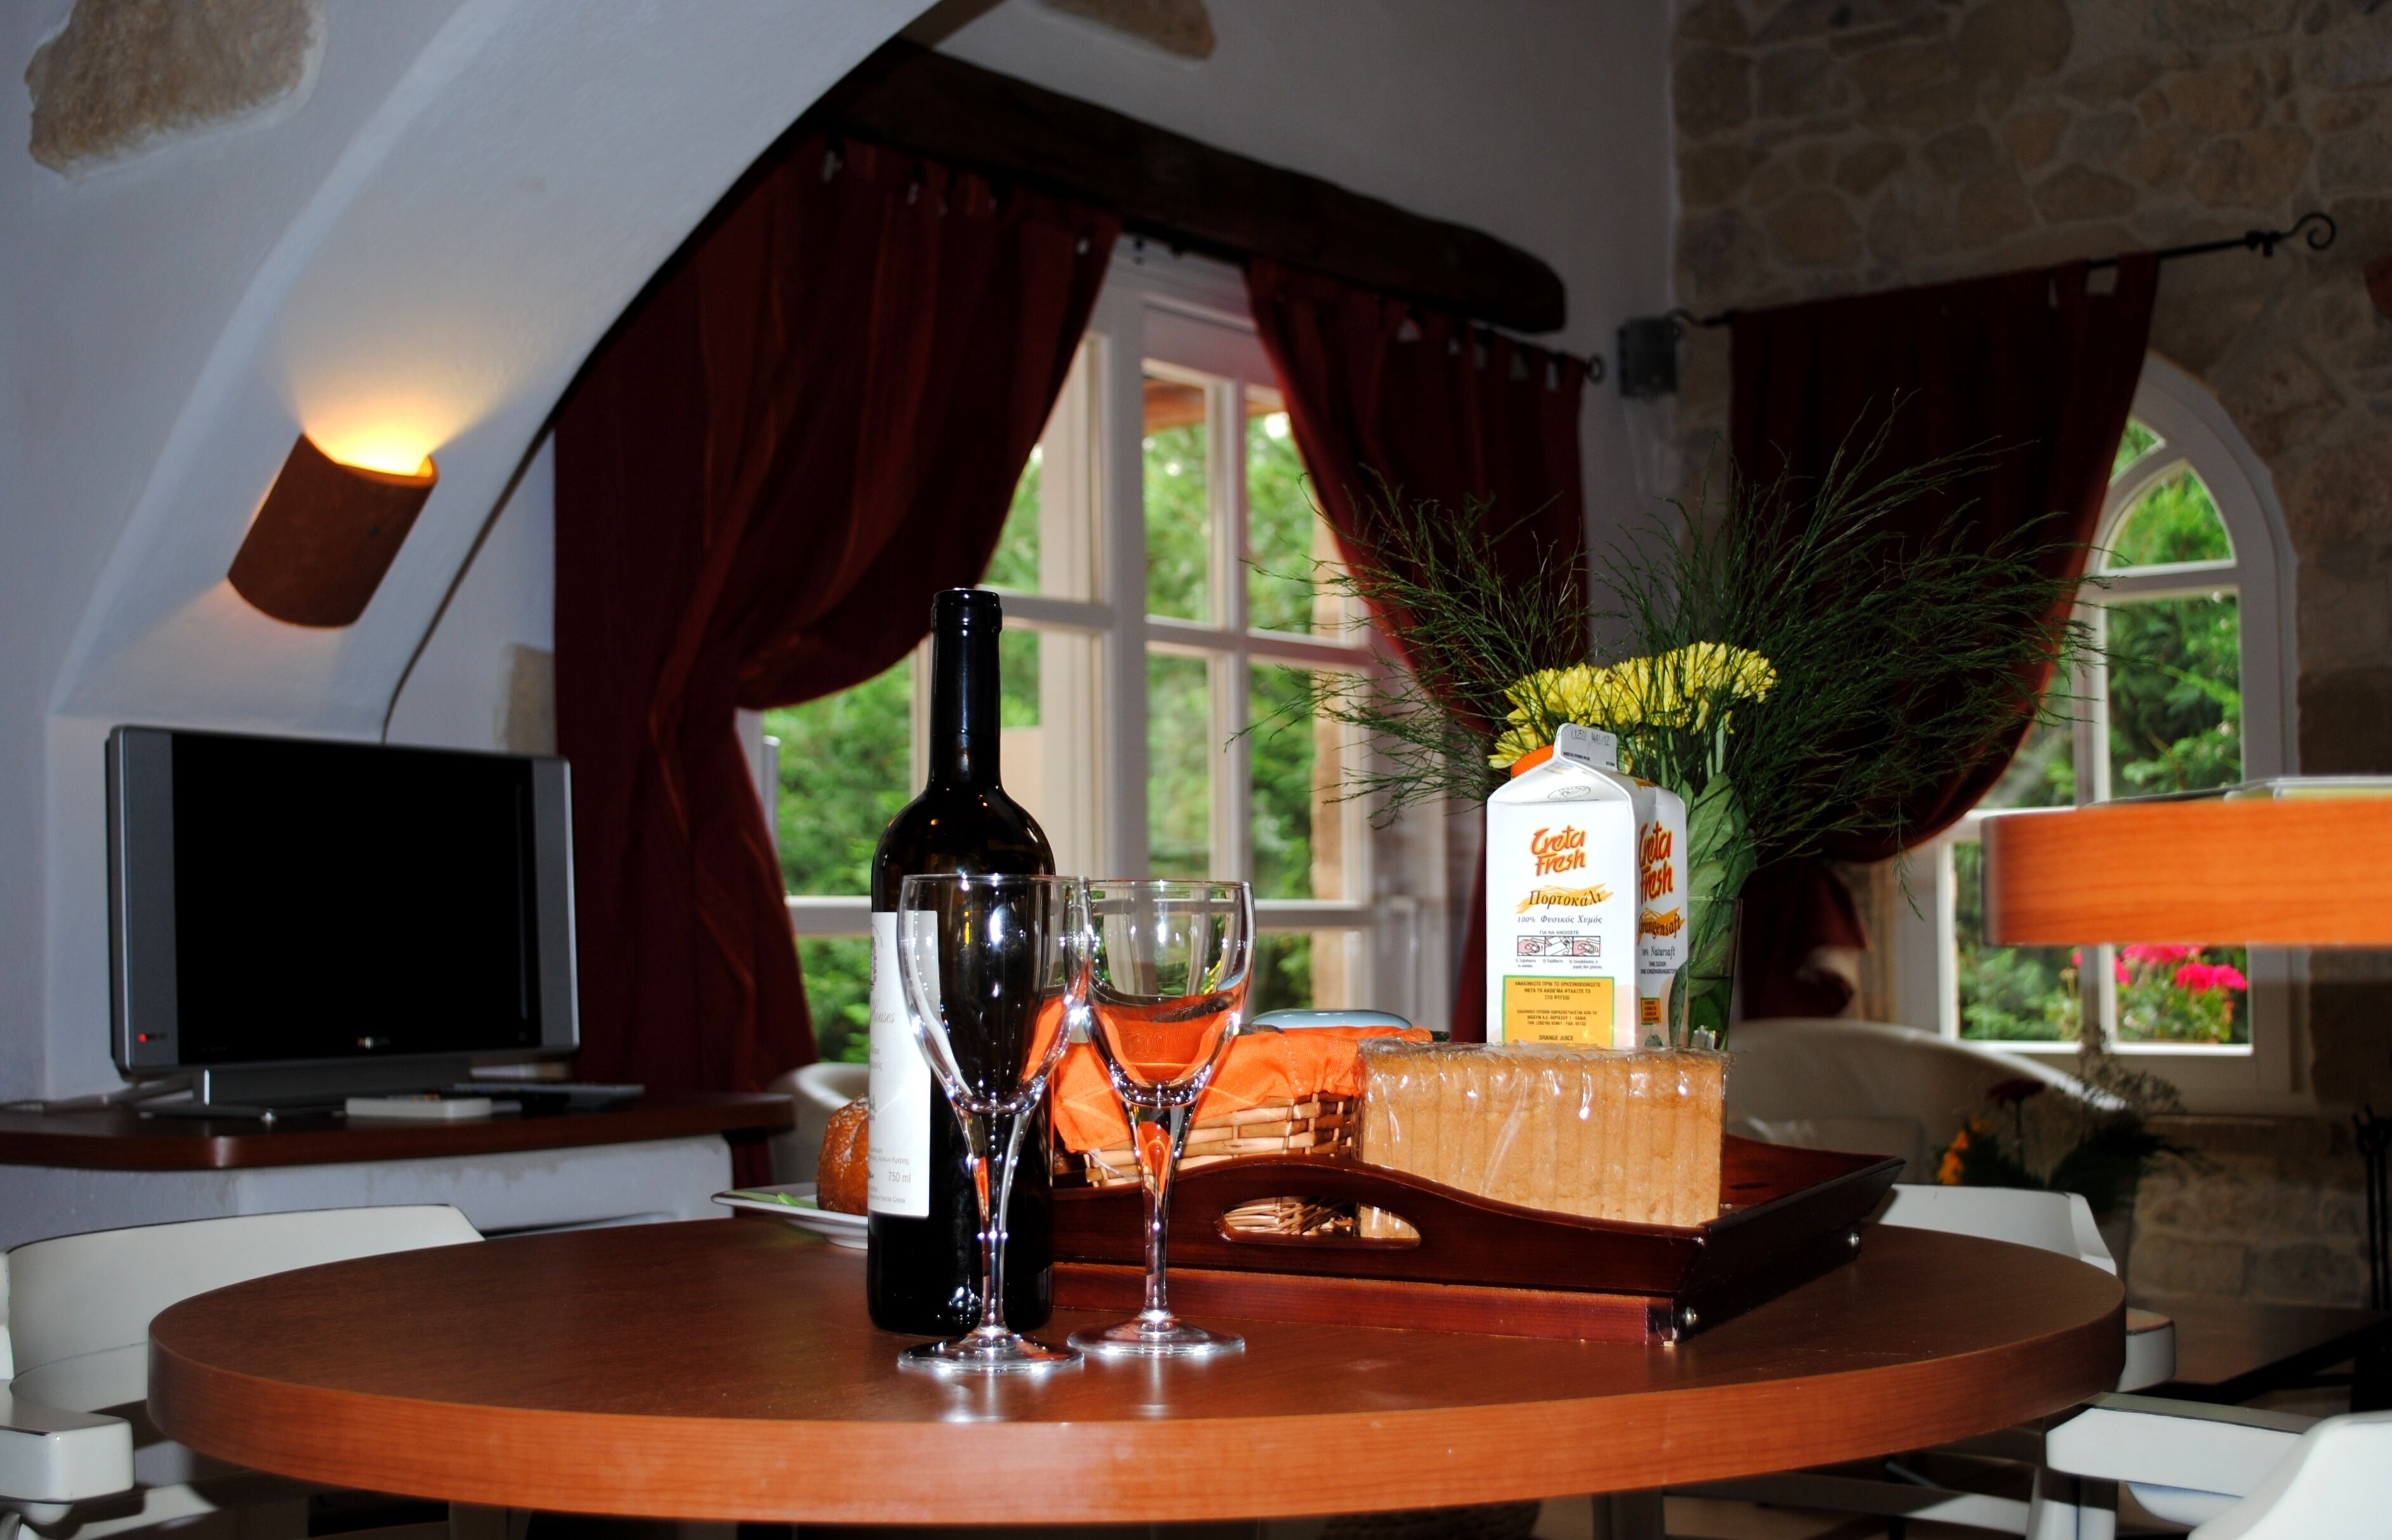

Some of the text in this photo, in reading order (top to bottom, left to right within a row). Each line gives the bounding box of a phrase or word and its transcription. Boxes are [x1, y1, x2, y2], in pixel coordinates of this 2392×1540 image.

[1531, 825, 1586, 855] Creta
[1638, 820, 1673, 867] Creta
[1534, 849, 1586, 877] Fresh
[1640, 861, 1673, 905] Fresh
[1529, 890, 1602, 910] Πορτοκάλι
[1540, 915, 1574, 924] Φυσικός
[1577, 915, 1602, 926] Χυμός
[1639, 913, 1681, 939] Orangensaft
[1651, 945, 1675, 960] Natursaft
[888, 1171, 911, 1183] 750 ml
